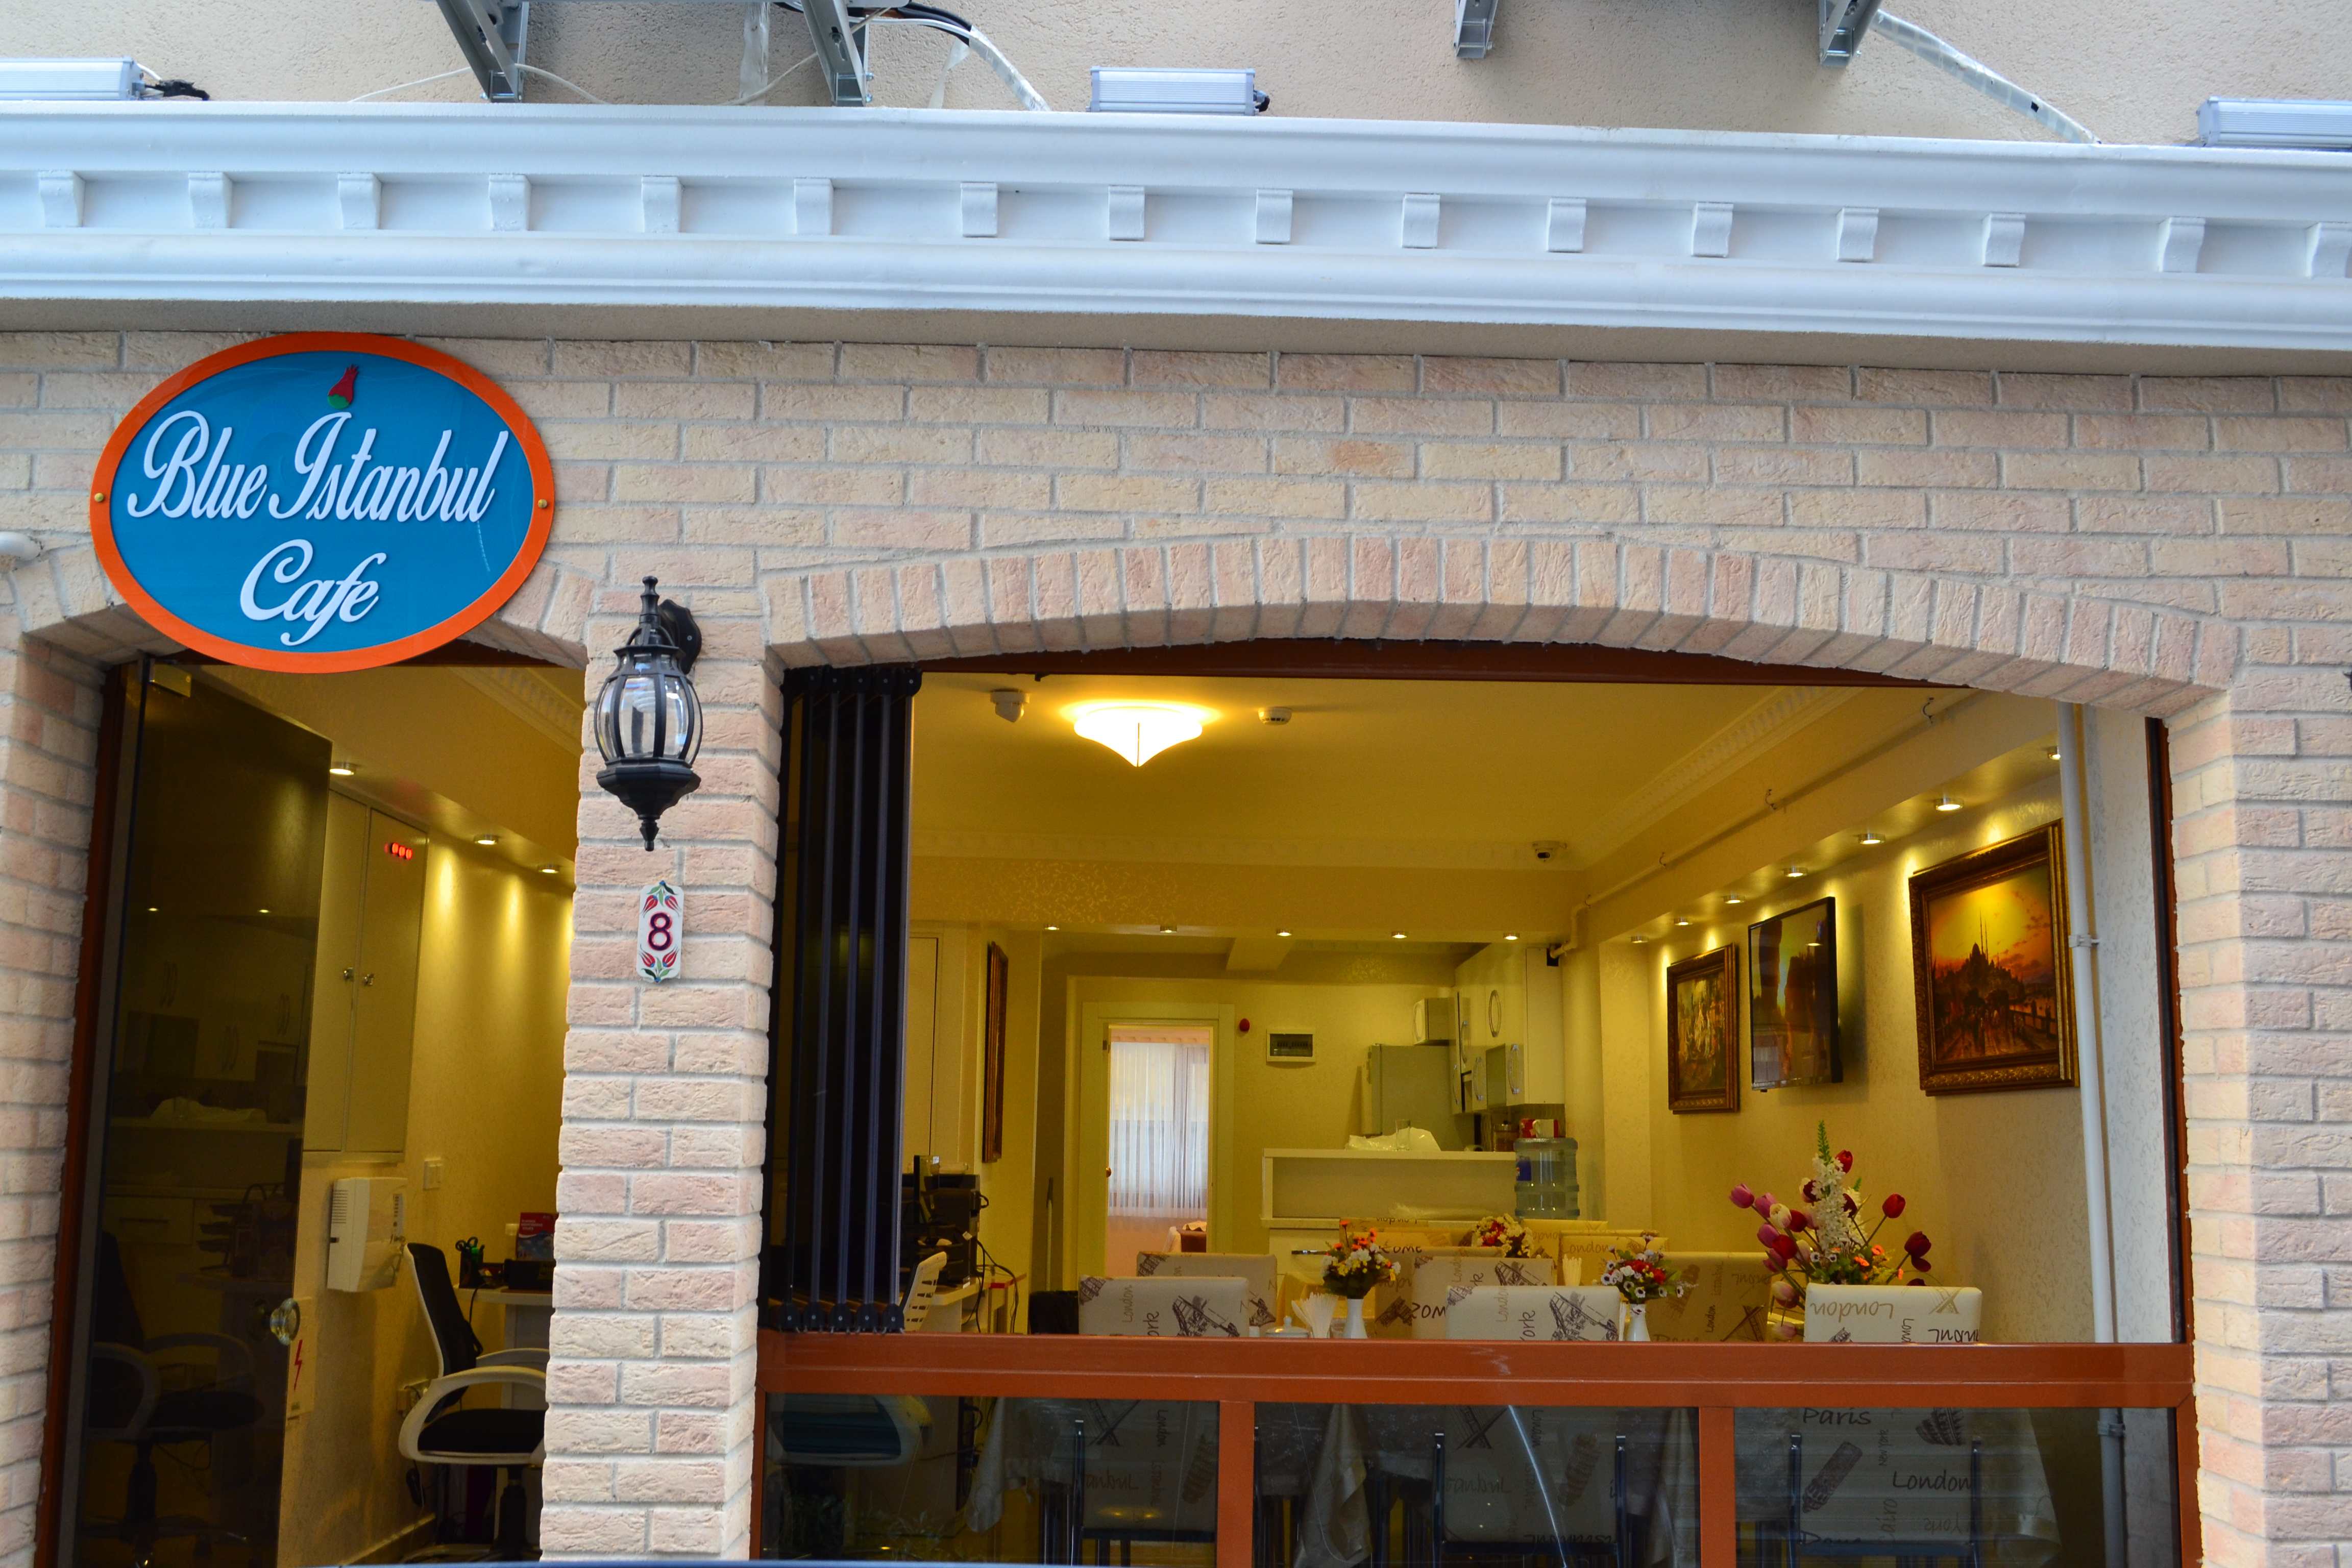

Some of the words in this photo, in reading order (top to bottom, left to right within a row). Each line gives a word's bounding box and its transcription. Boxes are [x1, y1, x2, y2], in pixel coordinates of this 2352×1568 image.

[127, 410, 267, 519] Blue
[240, 539, 386, 647] Cafe
[647, 911, 673, 951] 8
[1142, 1311, 1160, 1336] ork
[1810, 1302, 1894, 1323] London
[1802, 1408, 1871, 1425] Paris
[1893, 1469, 1972, 1491] London
